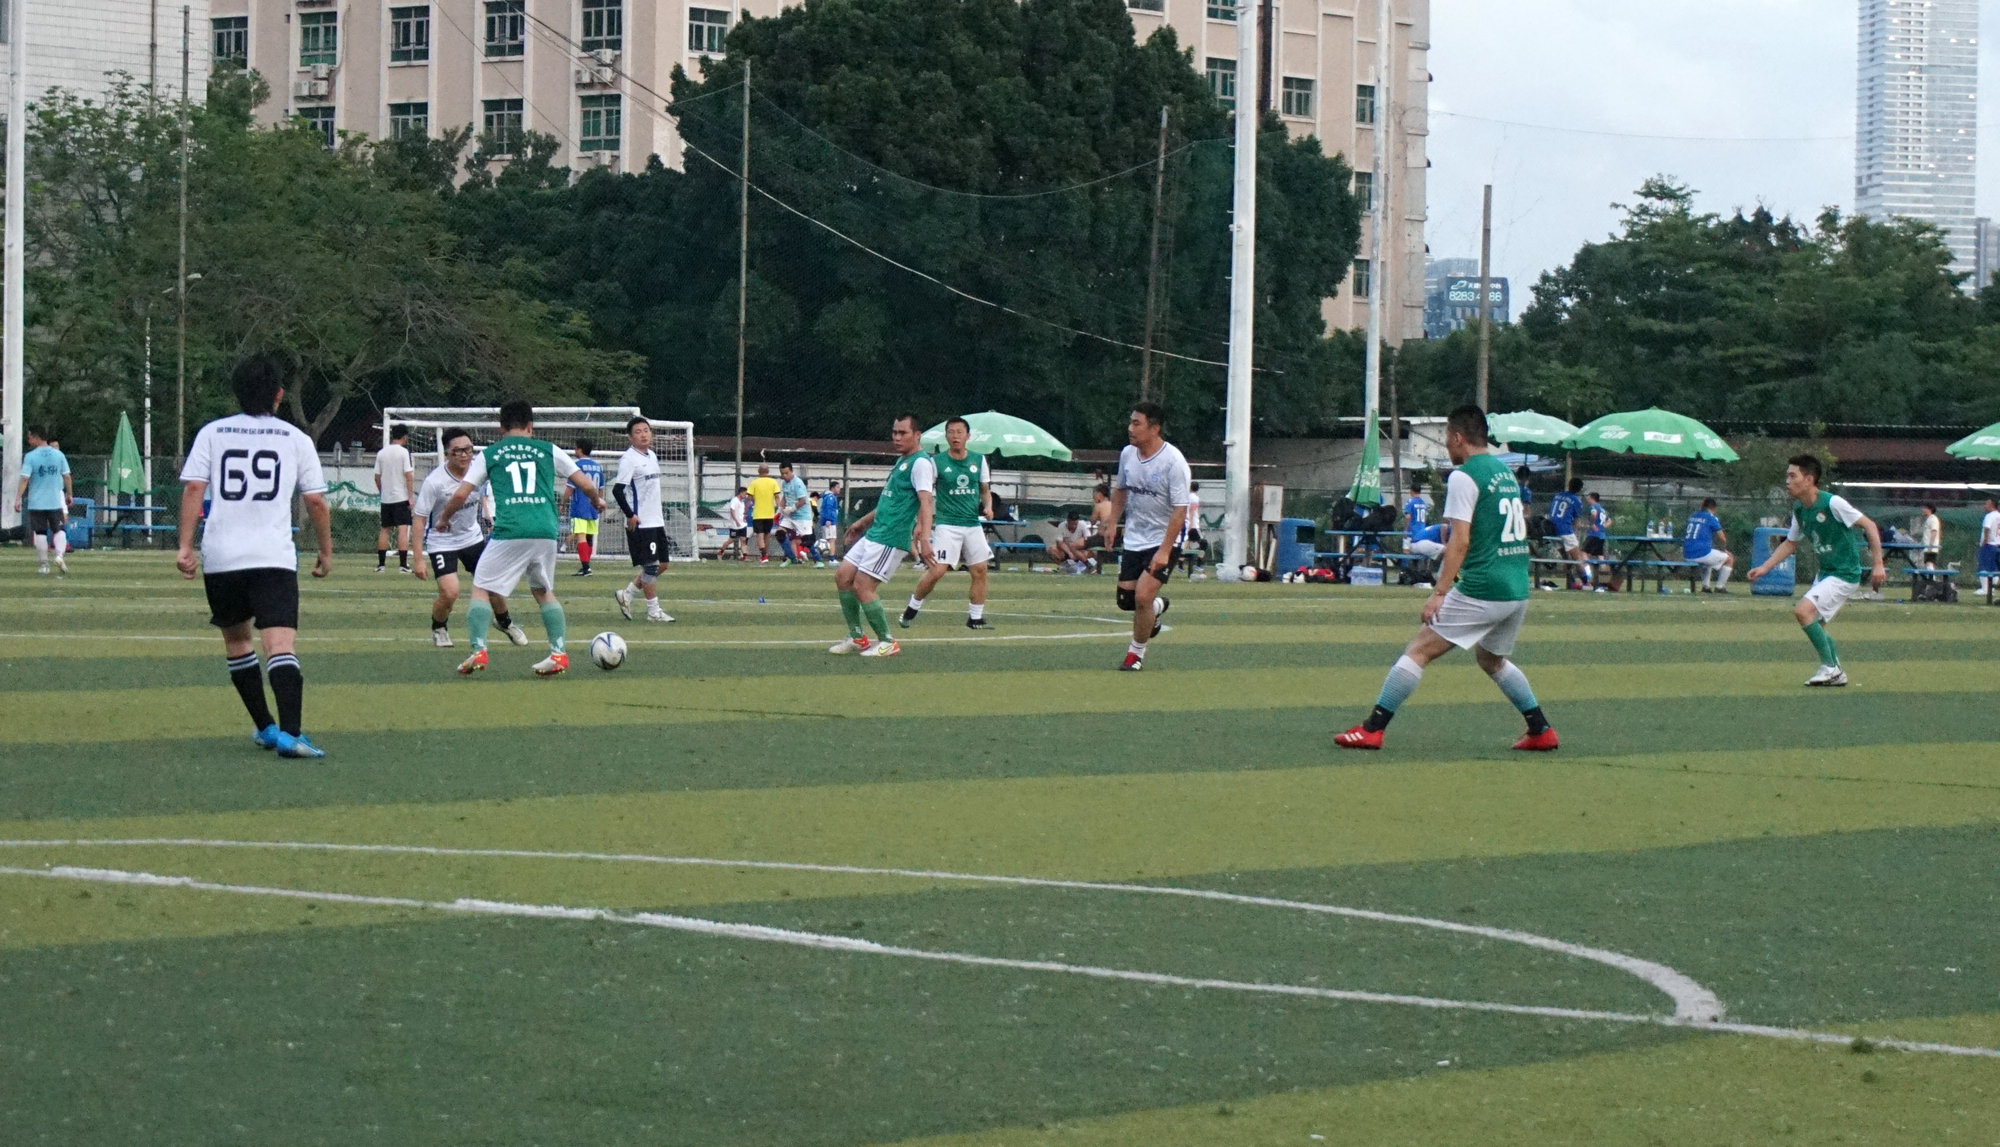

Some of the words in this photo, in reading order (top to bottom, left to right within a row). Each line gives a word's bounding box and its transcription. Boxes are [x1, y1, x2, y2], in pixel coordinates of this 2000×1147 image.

[220, 449, 281, 501] 69
[505, 461, 537, 494] 17
[1416, 508, 1426, 523] 10
[1551, 500, 1568, 518] 19
[1498, 497, 1528, 543] 28
[649, 541, 657, 555] 9
[937, 549, 947, 561] 14
[435, 554, 446, 570] 3
